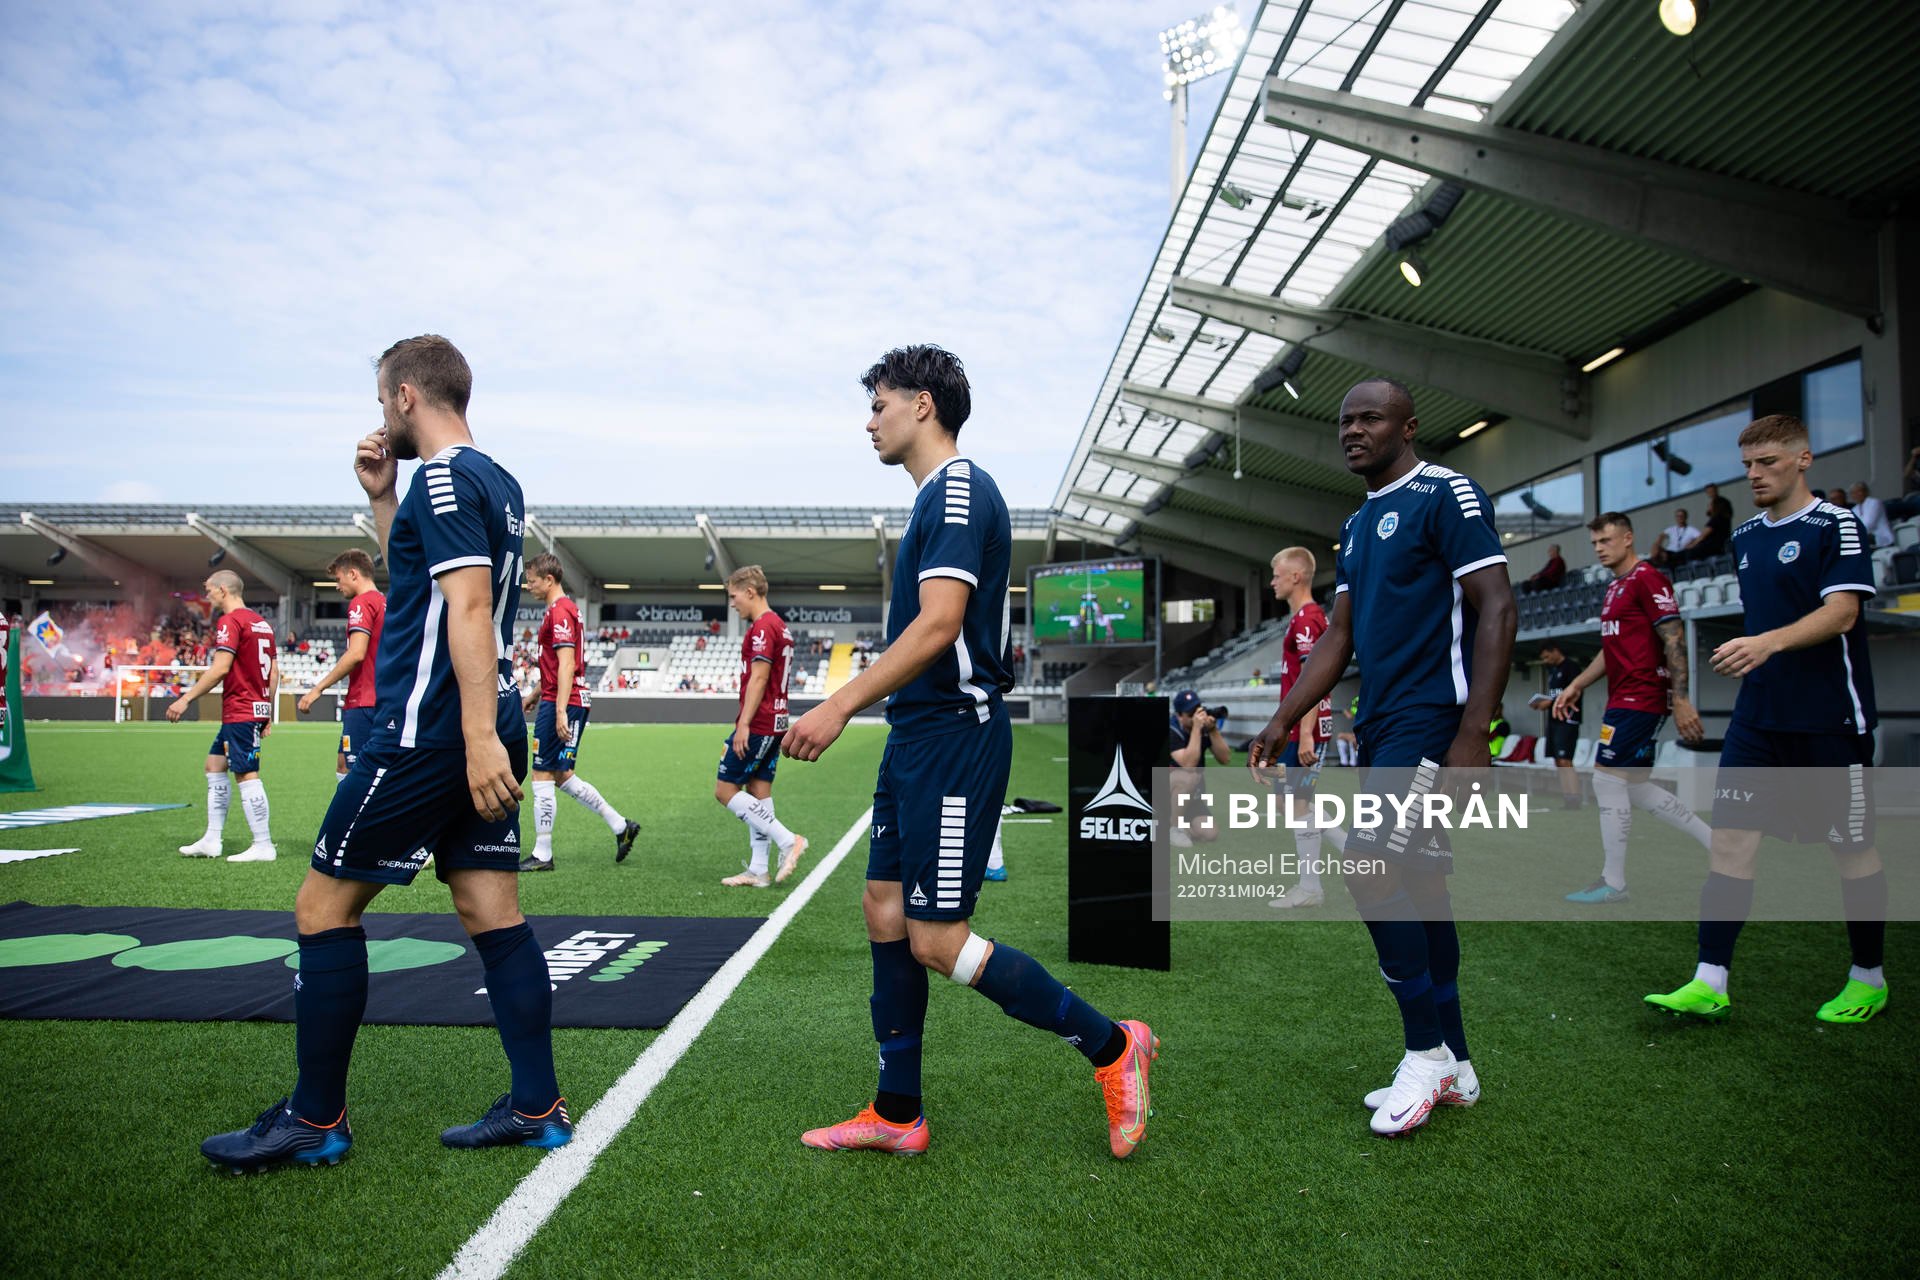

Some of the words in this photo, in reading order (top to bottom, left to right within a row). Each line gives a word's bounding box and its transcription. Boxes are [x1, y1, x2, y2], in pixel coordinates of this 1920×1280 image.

[651, 607, 702, 620] bravida
[800, 608, 851, 622] bravida
[258, 638, 272, 681] 5
[214, 785, 228, 810] MIKE
[250, 795, 268, 823] MIKE
[539, 796, 553, 827] MIKE
[1080, 816, 1159, 842] SELECT
[377, 859, 424, 871] ONEPARTN
[909, 898, 929, 907] SELECT
